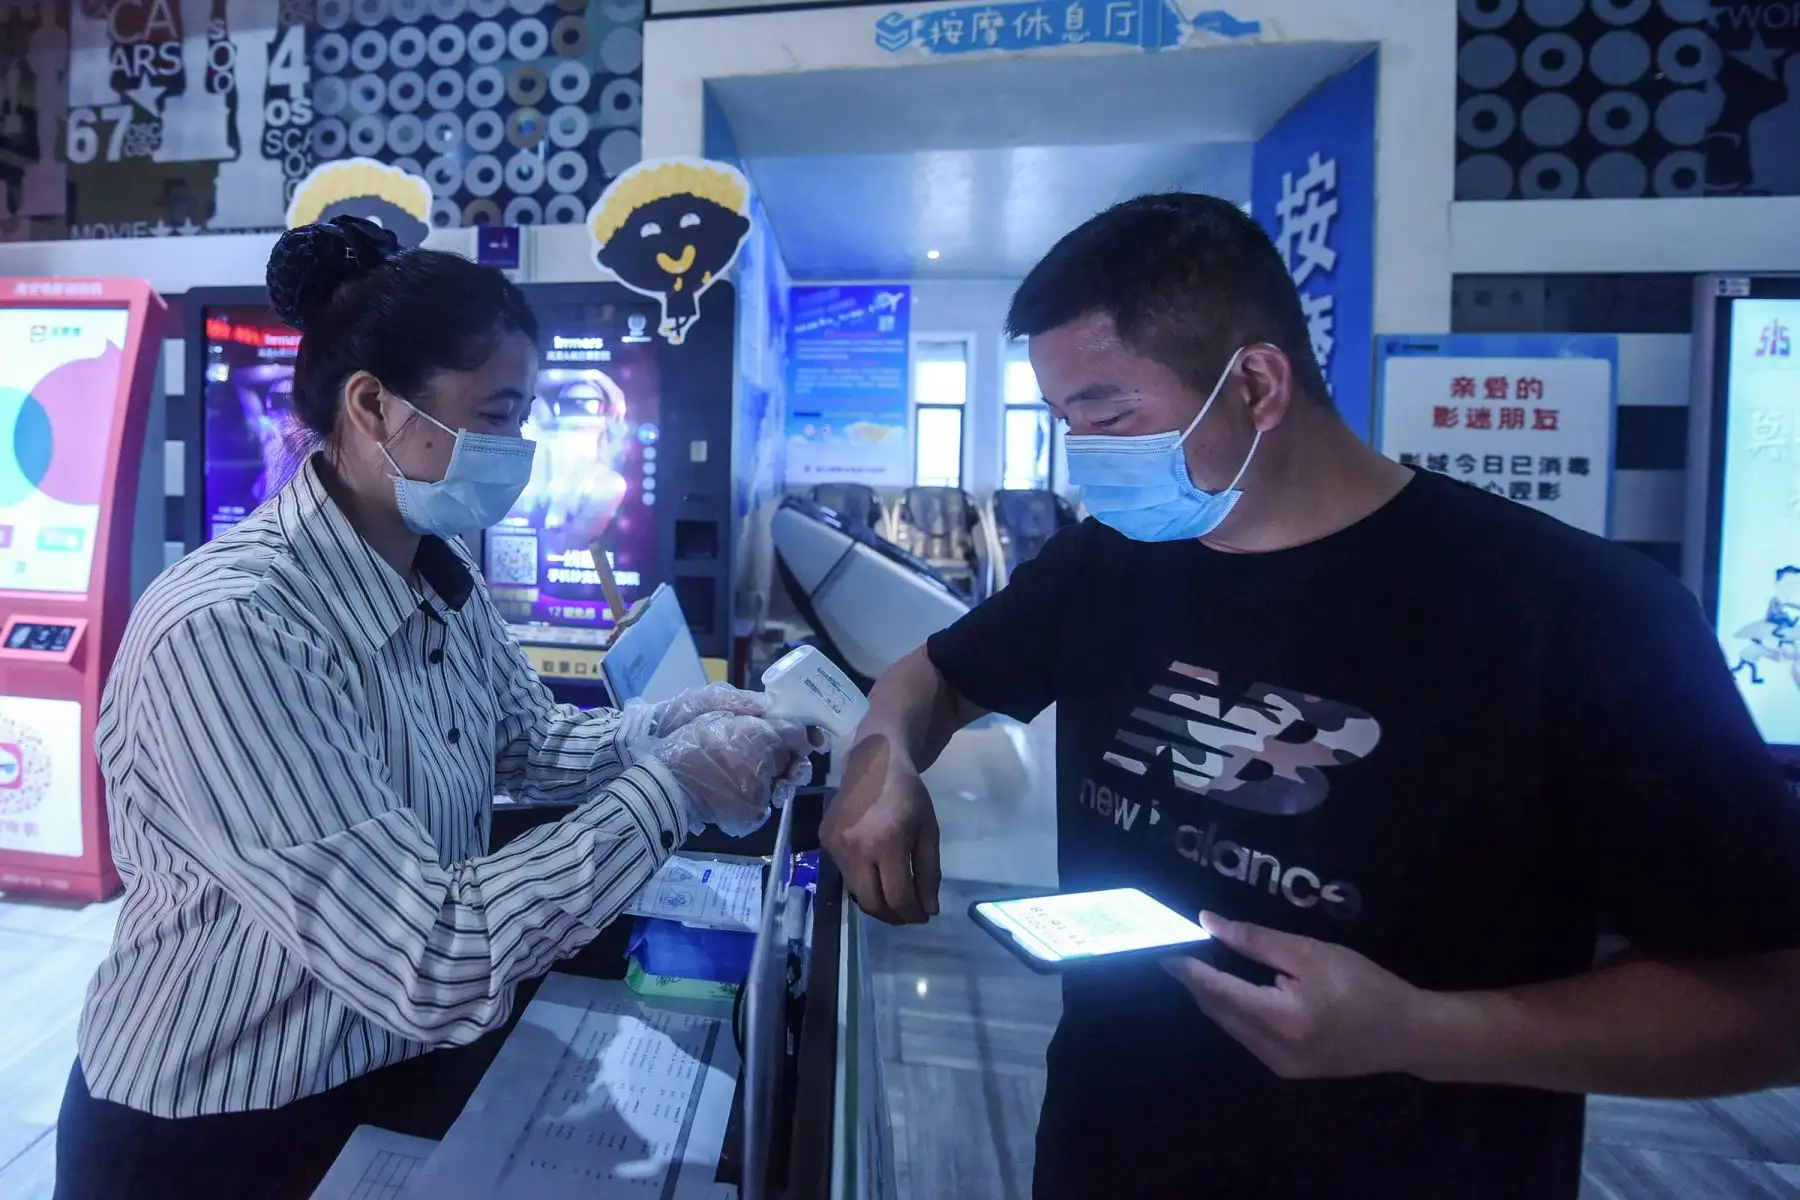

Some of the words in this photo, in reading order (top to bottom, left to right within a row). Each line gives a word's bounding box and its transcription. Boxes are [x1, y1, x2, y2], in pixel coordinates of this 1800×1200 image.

[928, 2, 1139, 45] 按摩休息厅
[67, 105, 133, 164] 67
[1450, 376, 1543, 400] 亲爱的
[1432, 405, 1560, 431] 影迷朋友
[1079, 777, 1140, 831] new
